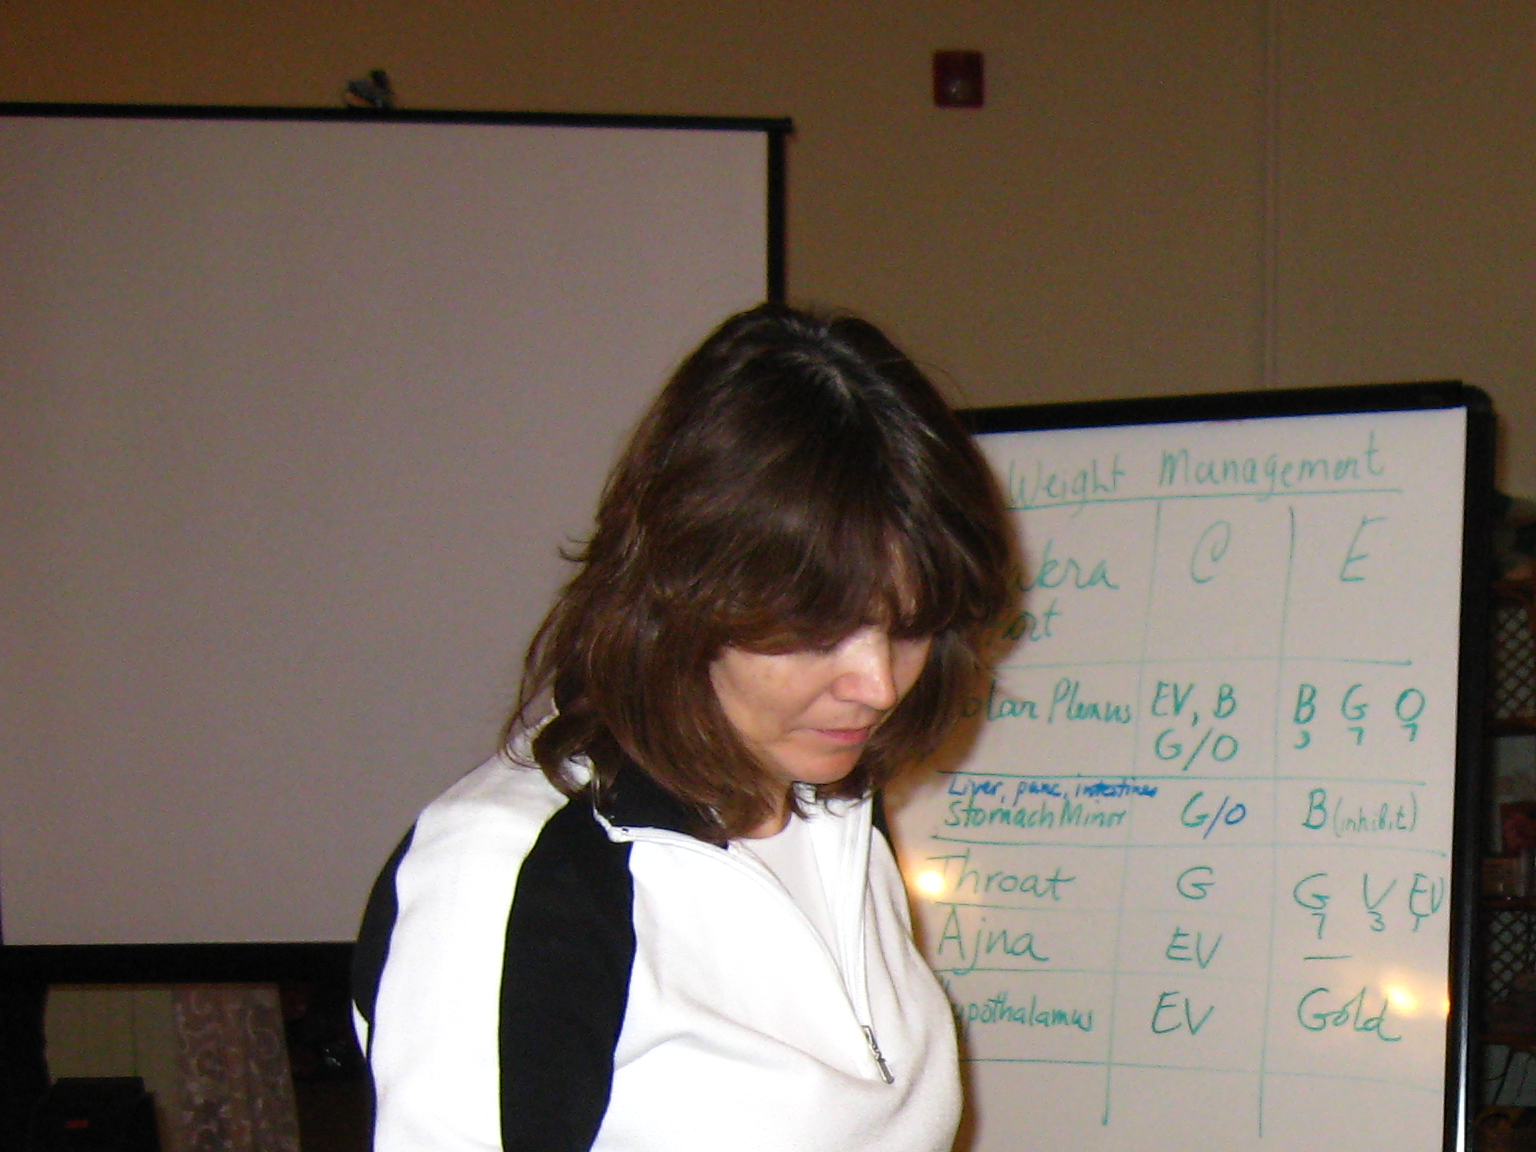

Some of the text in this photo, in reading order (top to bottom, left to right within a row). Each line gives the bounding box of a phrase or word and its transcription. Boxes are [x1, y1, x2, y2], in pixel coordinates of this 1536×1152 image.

[1008, 431, 1383, 518] Weight Management
[1191, 519, 1231, 584] C
[1338, 516, 1386, 583] E
[961, 678, 1040, 722] olar
[1213, 683, 1238, 719] B
[1293, 683, 1318, 725] B
[1341, 683, 1369, 721] G
[926, 848, 1076, 901] Throat
[1175, 866, 1214, 901] G
[1293, 872, 1331, 910] G
[1363, 873, 1397, 910] V
[937, 904, 1050, 976] Ajna
[1165, 926, 1224, 970] EV
[1151, 990, 1213, 1036] EV
[1297, 985, 1402, 1043] Gold
